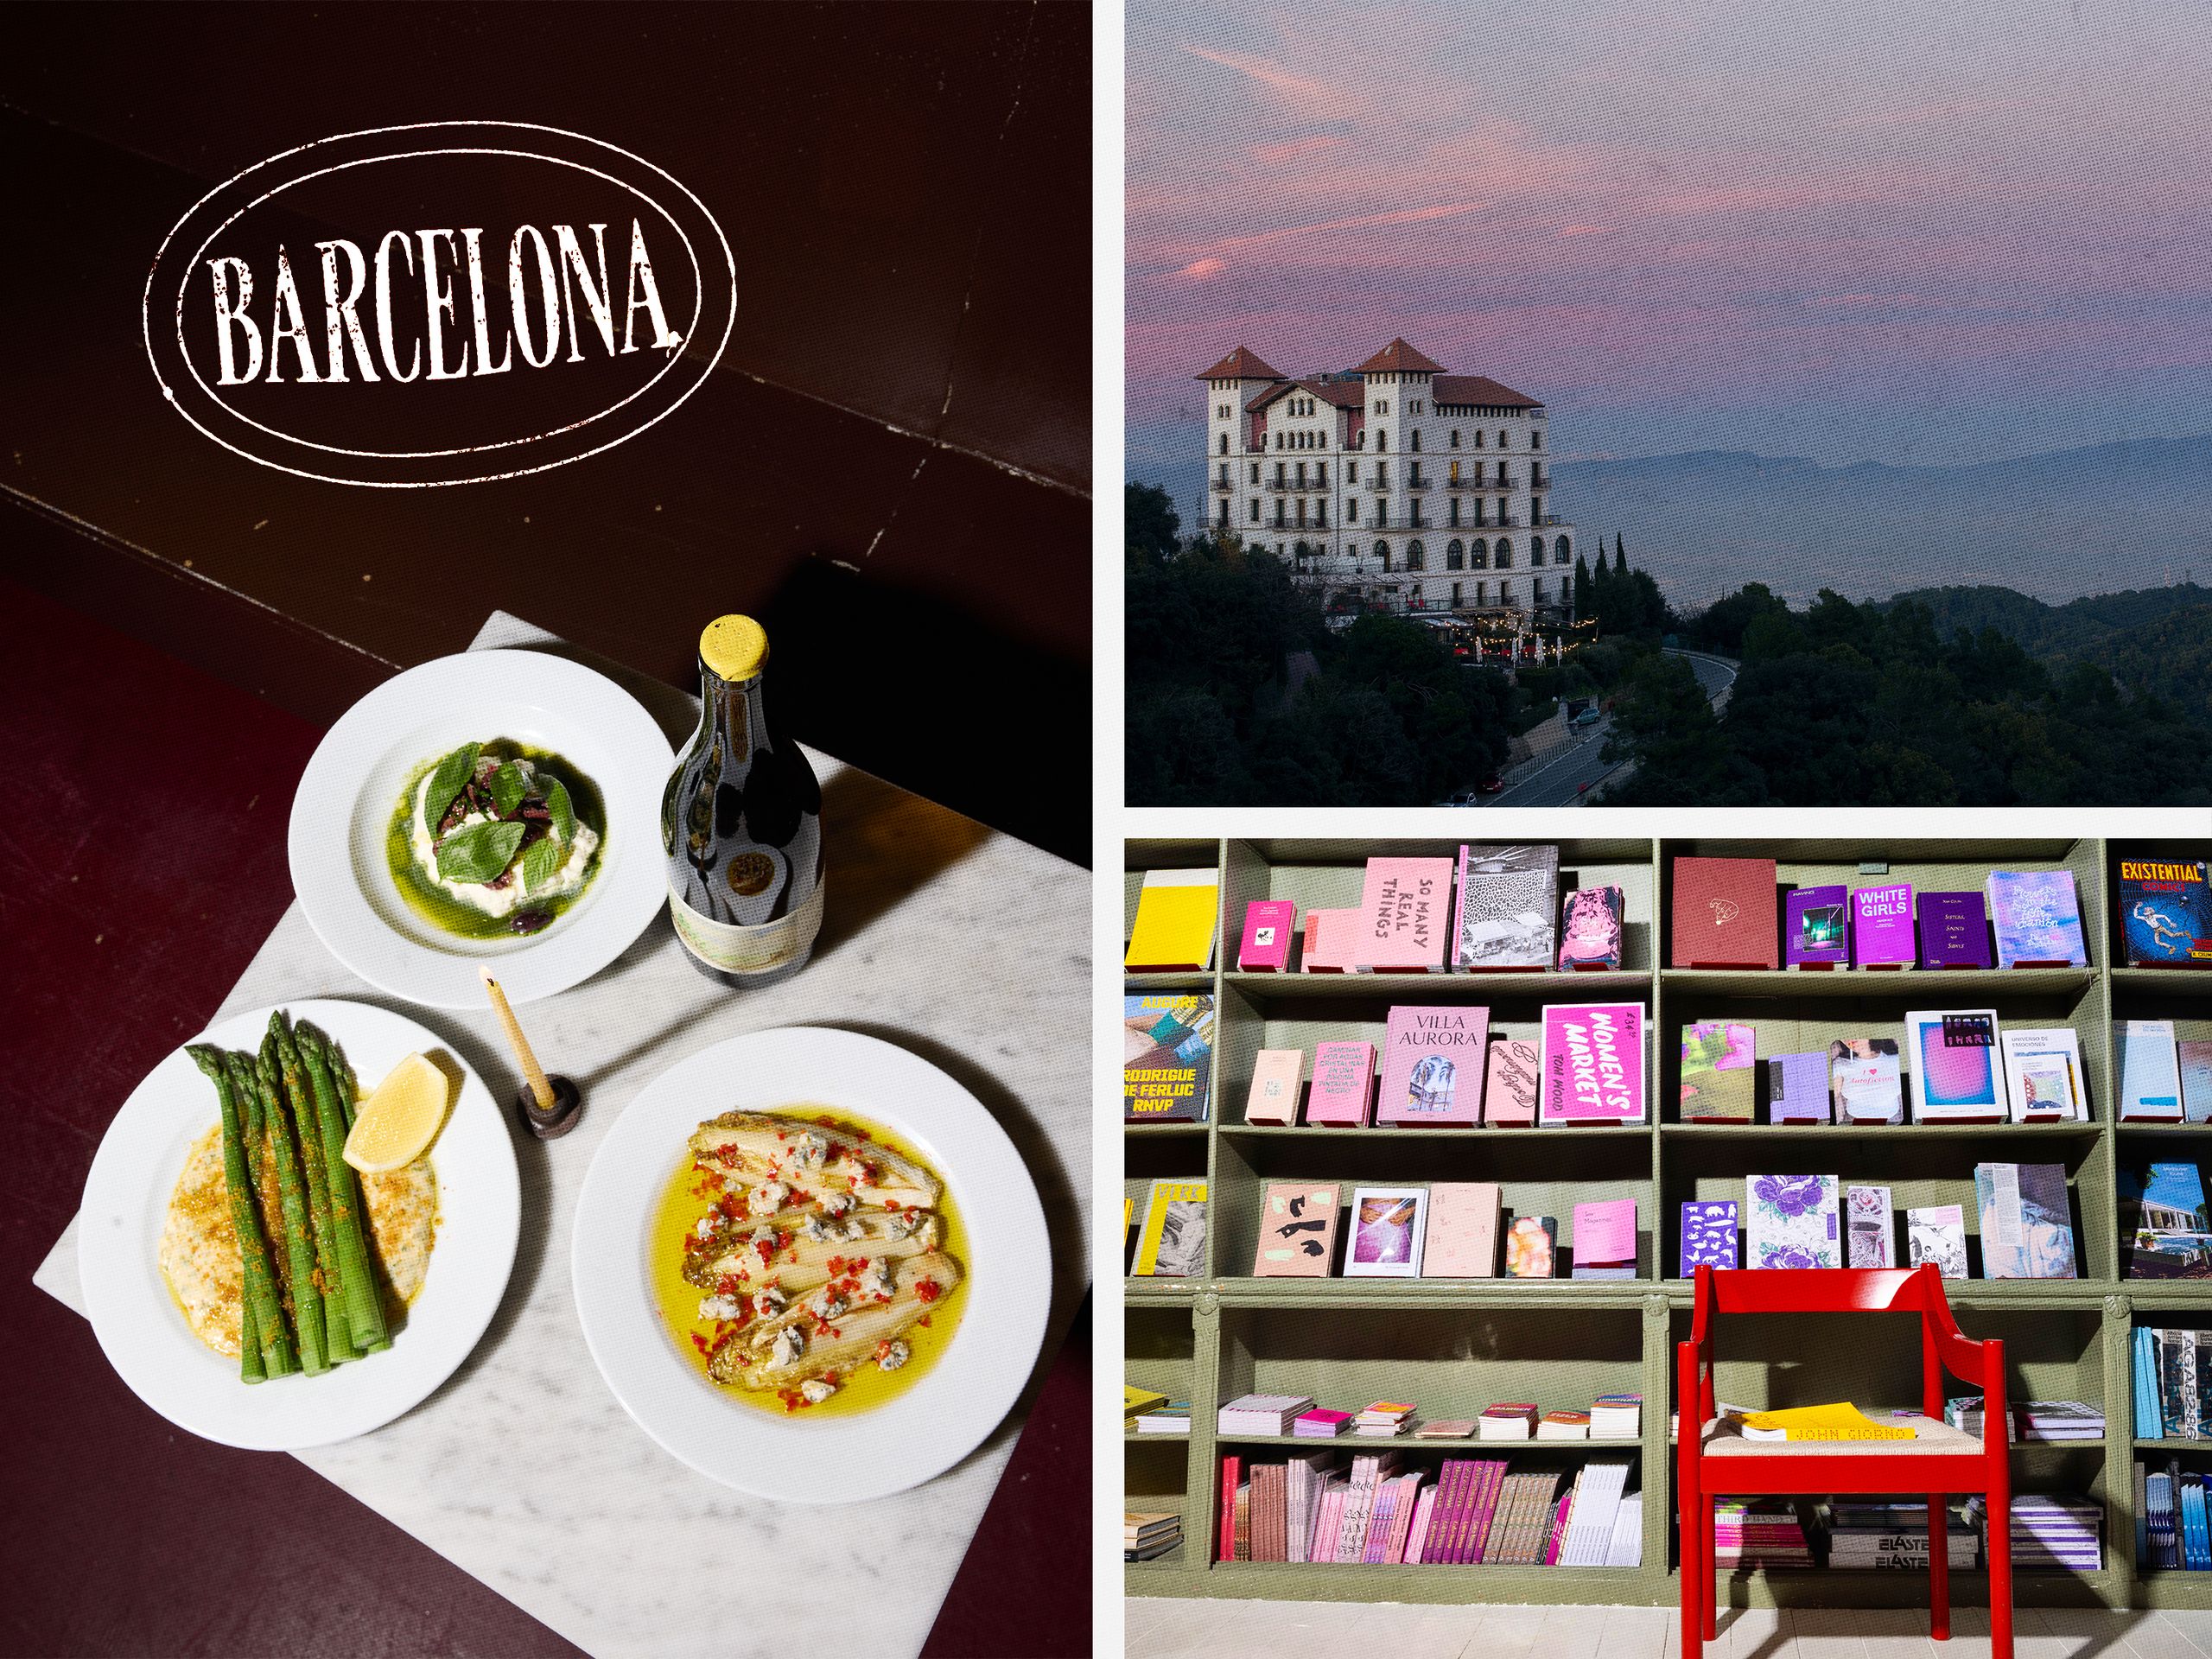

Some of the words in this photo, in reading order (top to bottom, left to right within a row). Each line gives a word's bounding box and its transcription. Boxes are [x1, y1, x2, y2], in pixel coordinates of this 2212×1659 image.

[2121, 862, 2202, 881] EXISTENTIAL
[1419, 878, 1433, 896] SO
[2143, 883, 2185, 892] COMICS
[1859, 888, 1908, 905] WHITE
[1395, 893, 1414, 931] REAL
[1861, 902, 1908, 917] GIRLS
[1413, 901, 1430, 949] MANY
[1141, 996, 1199, 1009] AUGURE
[1417, 1015, 1465, 1029] VILLA
[1399, 1032, 1478, 1046] AURORA
[1553, 1053, 1564, 1077] TOM
[1562, 1023, 1603, 1107] MARKET
[1589, 1012, 1632, 1110] WOMEN'S
[1139, 1084, 1195, 1096] FERLUC
[1552, 1078, 1565, 1111] WOOD
[1133, 1098, 1174, 1112] RNVP
[1796, 1428, 1840, 1440] JOHN
[1848, 1427, 1906, 1440] GIORNO
[1715, 1515, 1749, 1523] THIRD
